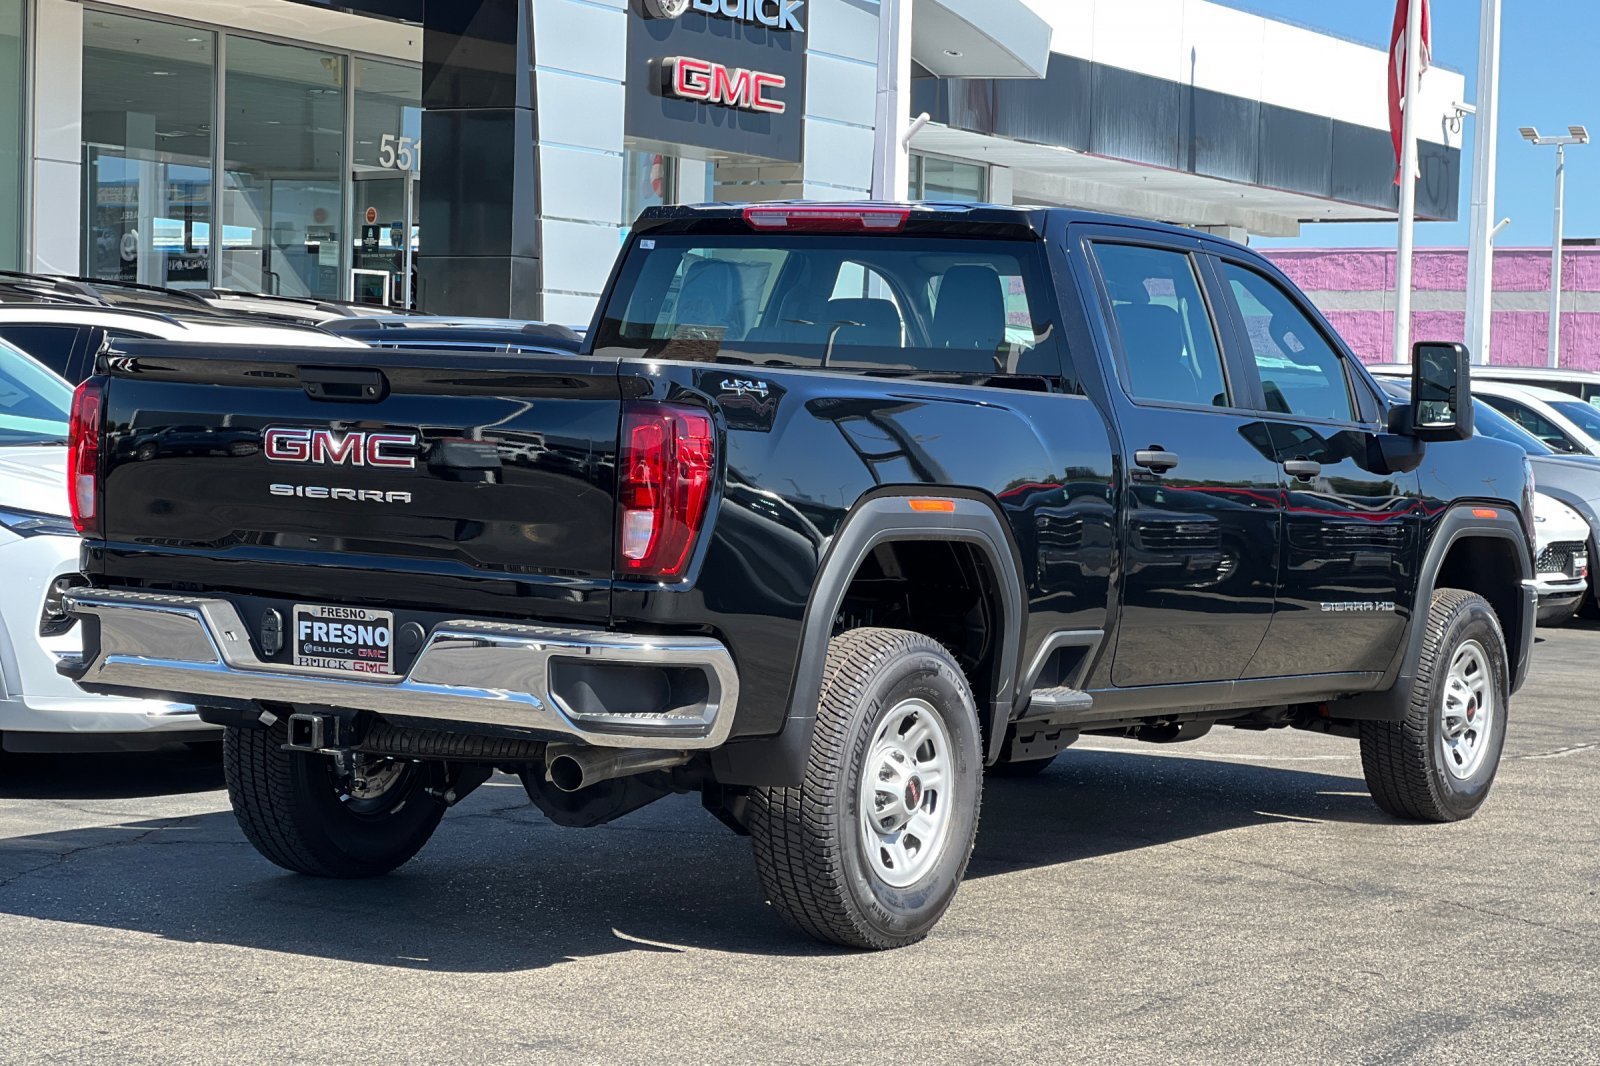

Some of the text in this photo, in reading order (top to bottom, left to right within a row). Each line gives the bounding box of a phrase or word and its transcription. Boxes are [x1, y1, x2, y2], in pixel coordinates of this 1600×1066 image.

[672, 56, 786, 114] GMC
[264, 427, 417, 469] GMC
[269, 483, 412, 504] SIERRA
[320, 606, 366, 620] FRESNO
[1320, 601, 1396, 612] SIERRA HD
[299, 620, 390, 648] FRESNO
[312, 646, 387, 659] BUICK GMC
[299, 656, 389, 675] BUICK GMC
